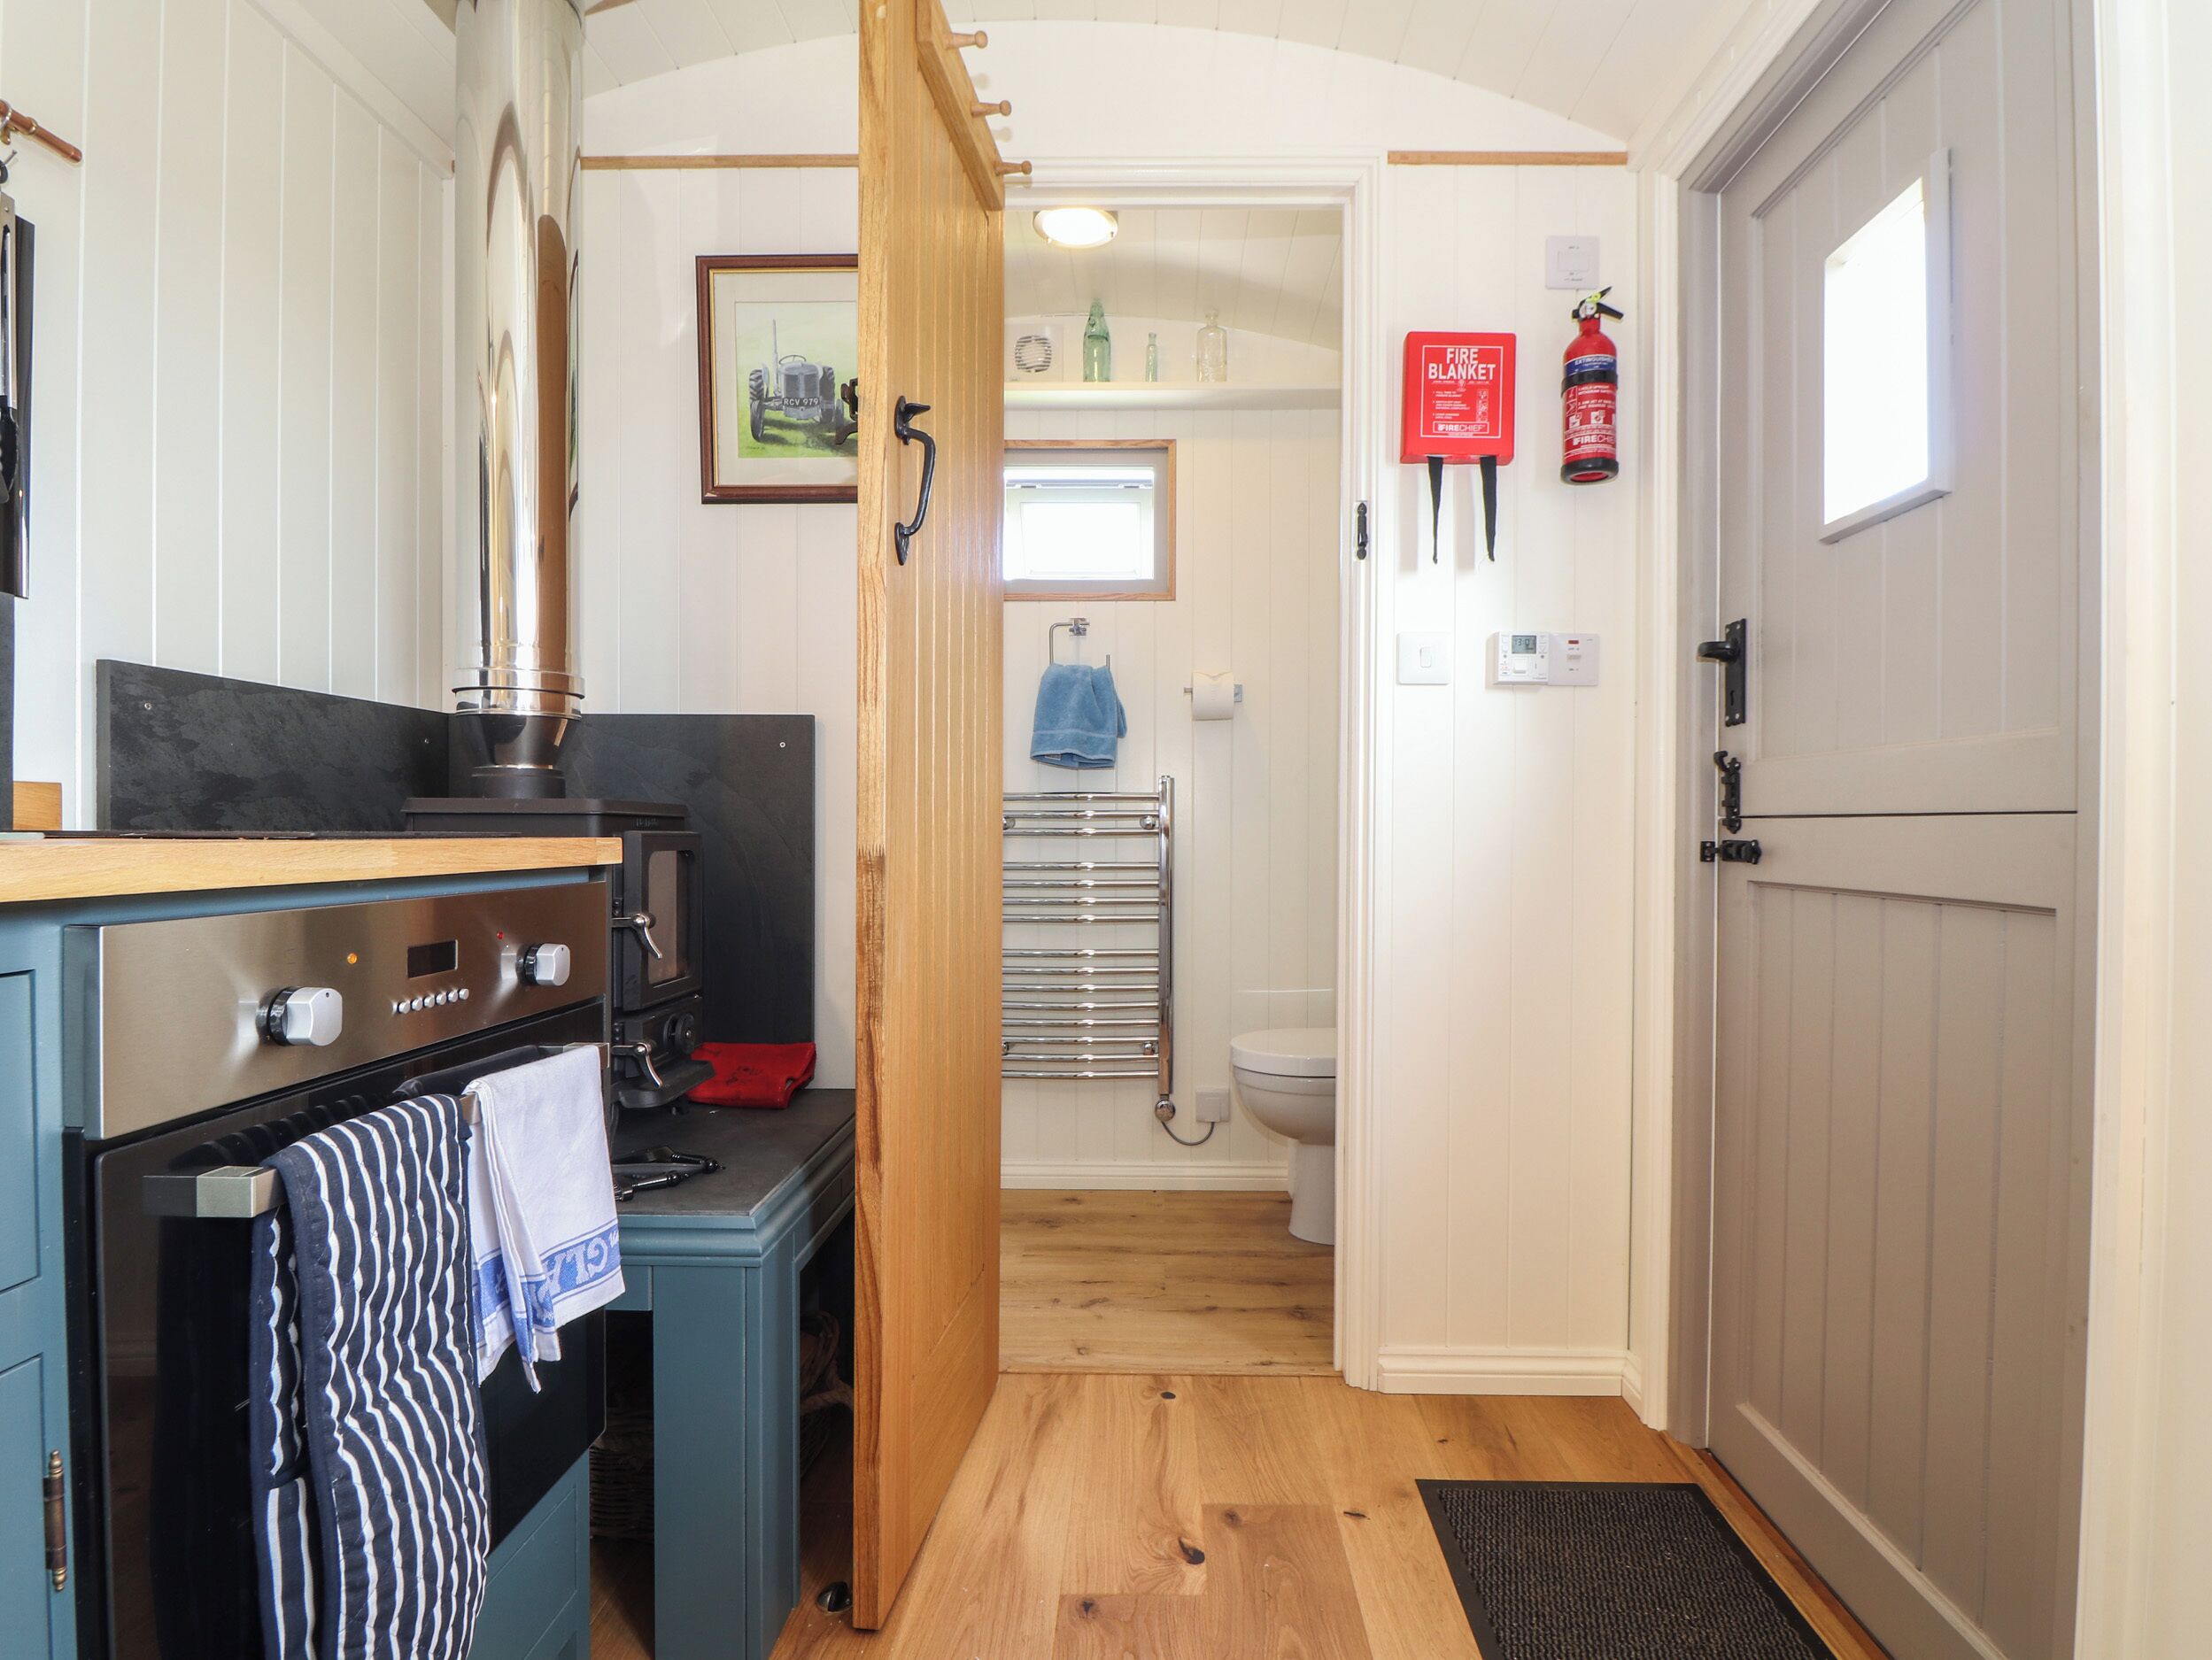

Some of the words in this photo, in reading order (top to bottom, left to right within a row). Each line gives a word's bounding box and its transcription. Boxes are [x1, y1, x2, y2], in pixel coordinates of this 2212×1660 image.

[1446, 347, 1479, 364] FIRE
[1428, 363, 1497, 380] BLANKET
[1438, 423, 1486, 432] FIRECHIEF
